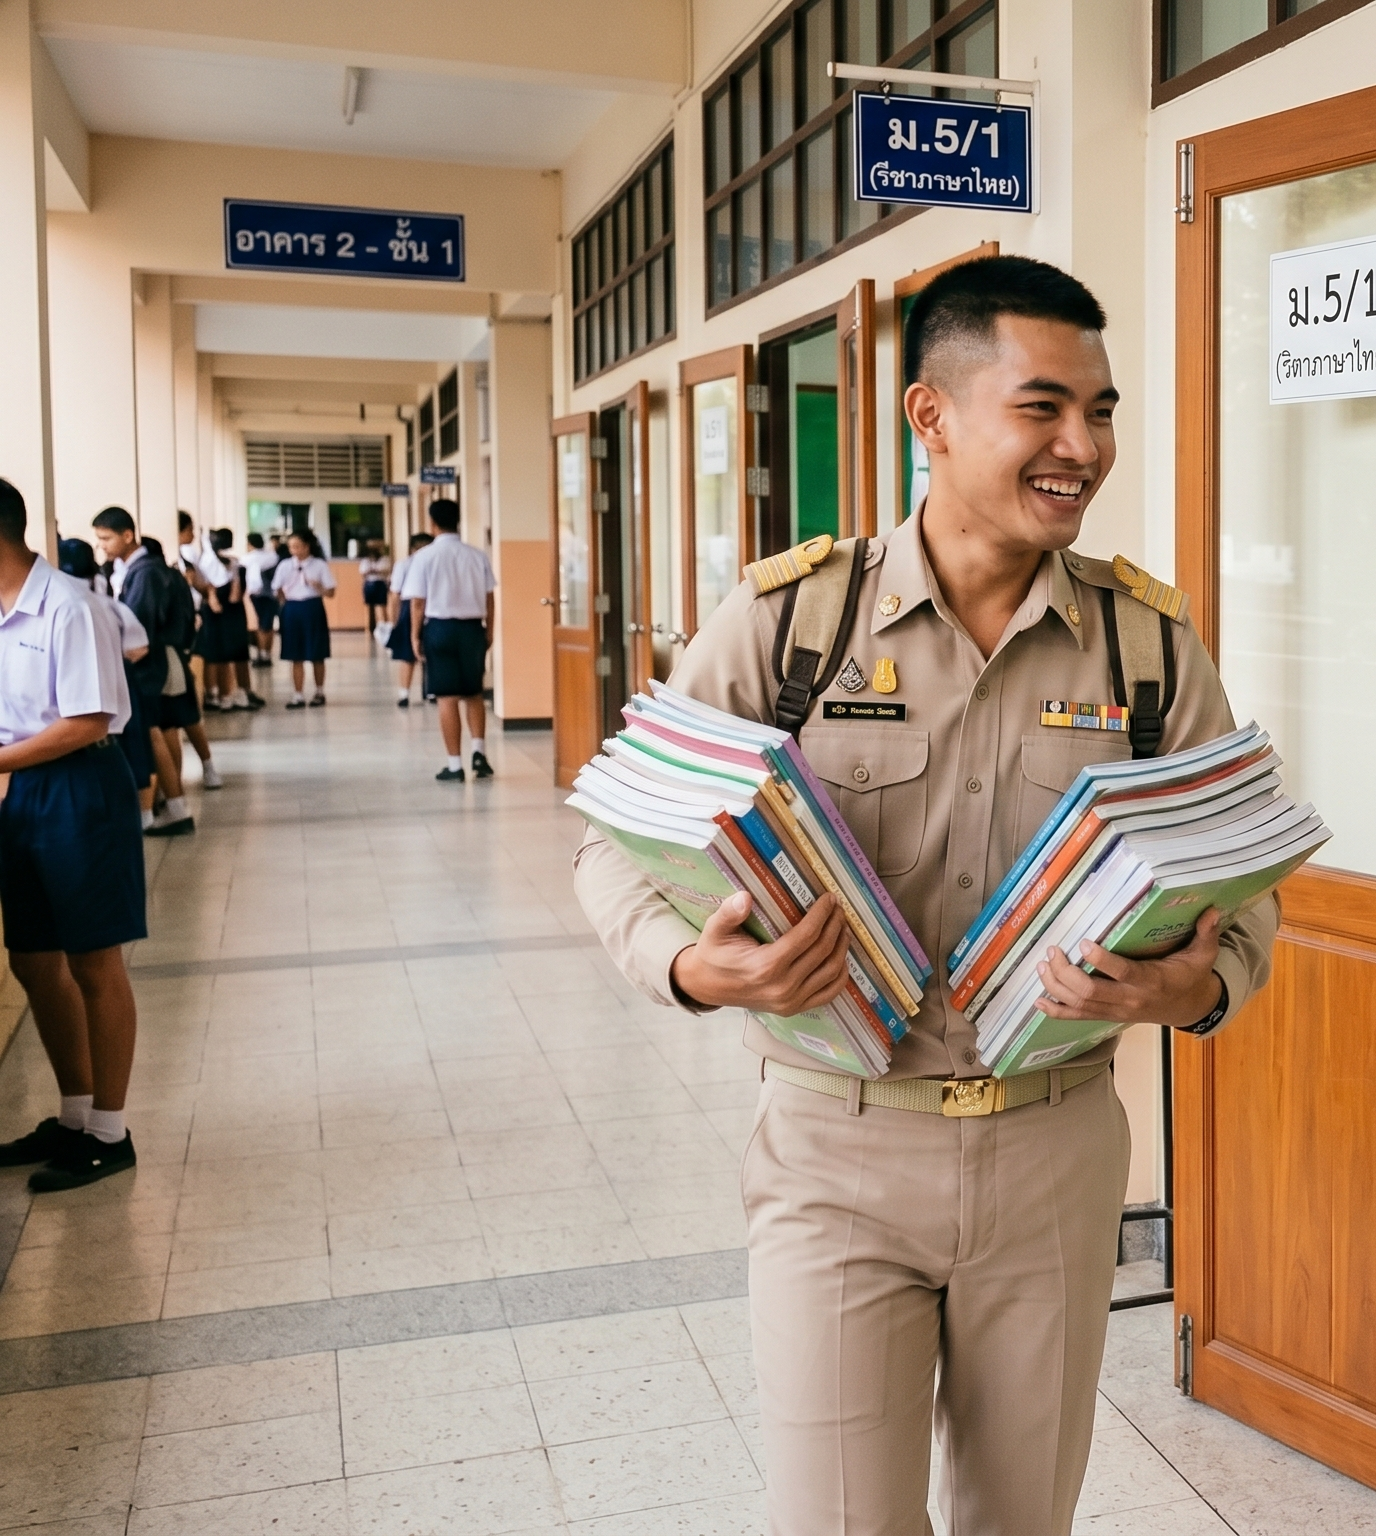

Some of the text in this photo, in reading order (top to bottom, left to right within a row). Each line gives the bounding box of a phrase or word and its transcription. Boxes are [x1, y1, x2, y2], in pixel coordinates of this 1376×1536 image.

[888, 118, 999, 159] ม.5/1
[235, 229, 327, 257] อาคาร
[336, 231, 356, 258] 2
[388, 217, 430, 264] ชั้น
[441, 239, 454, 265] 1
